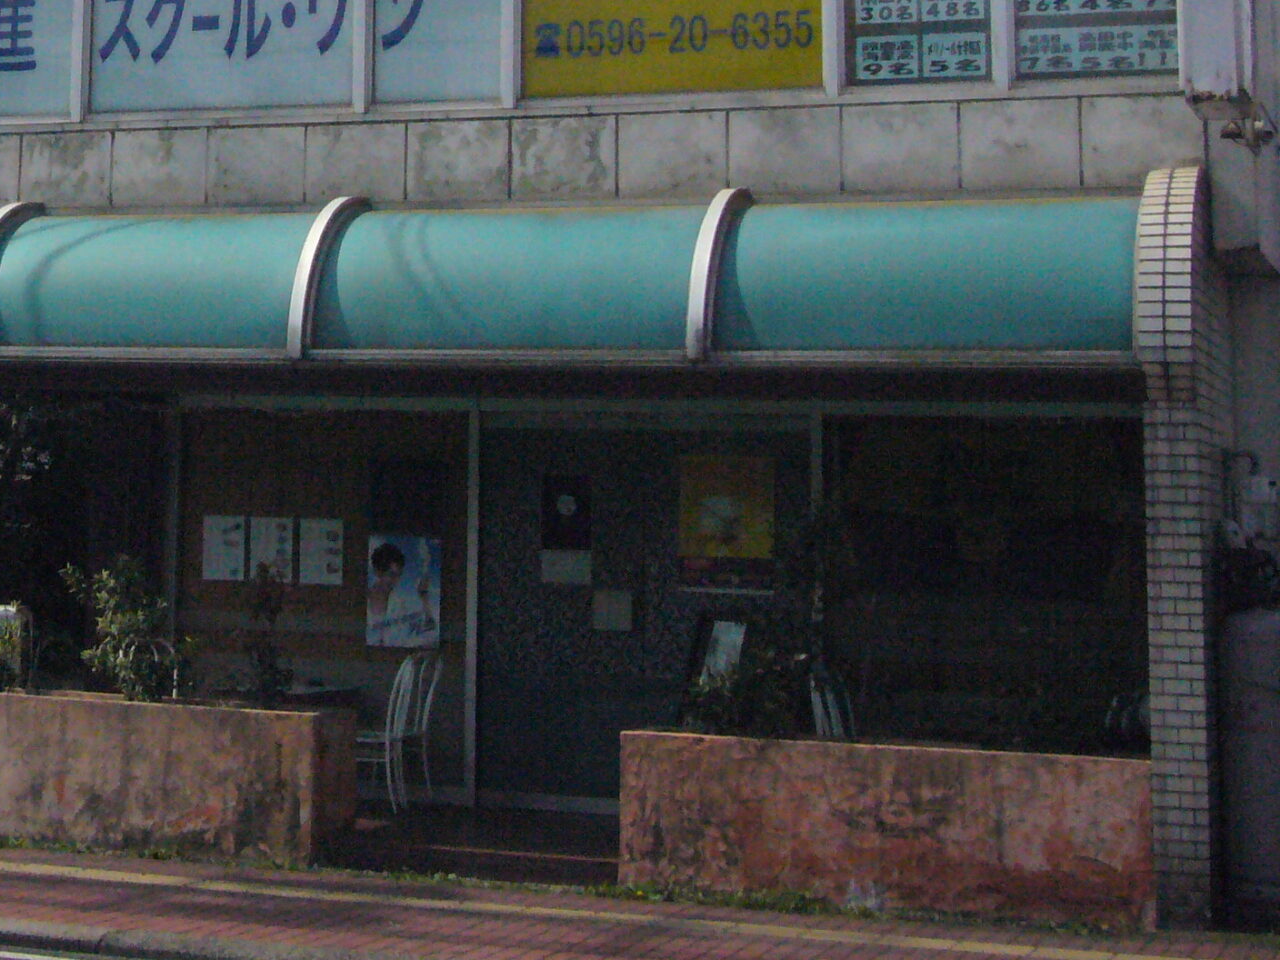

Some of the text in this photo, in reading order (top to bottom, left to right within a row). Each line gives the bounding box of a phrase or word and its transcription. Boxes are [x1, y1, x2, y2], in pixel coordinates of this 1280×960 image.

[860, 1, 980, 22] 30名 48名
[565, 9, 814, 59] 0596-20-6355
[862, 58, 982, 76] 9名 5名
